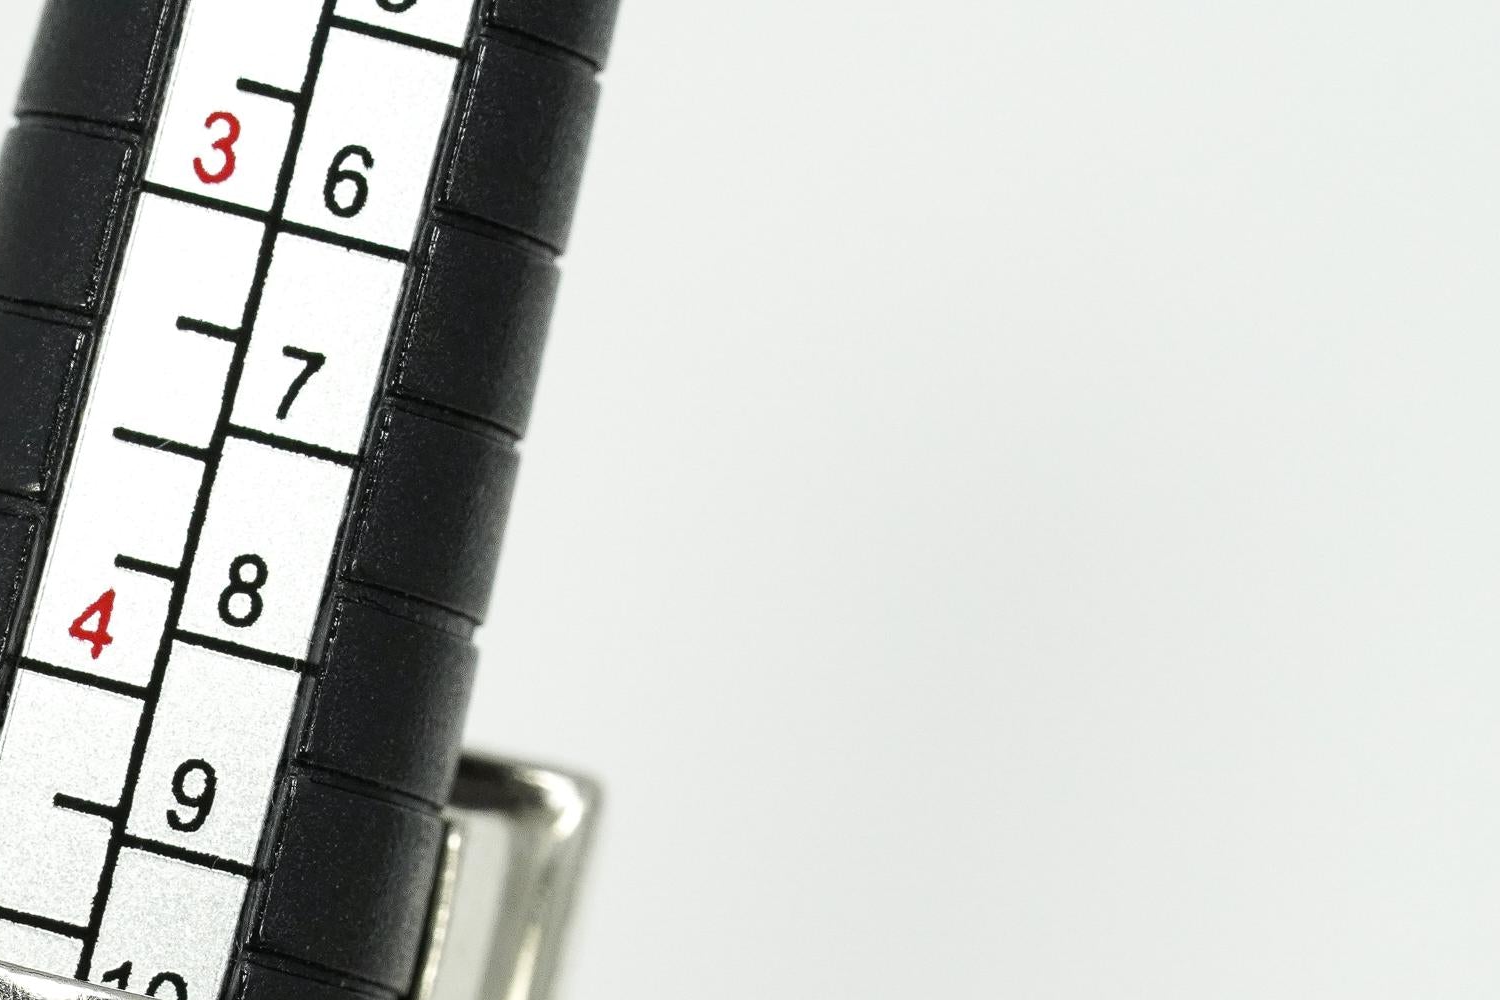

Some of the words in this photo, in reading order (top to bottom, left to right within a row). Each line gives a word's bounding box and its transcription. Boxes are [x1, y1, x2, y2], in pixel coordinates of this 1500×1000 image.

[193, 111, 241, 184] 3
[323, 144, 375, 218] 6
[282, 345, 327, 420] 7
[68, 588, 116, 660] 4
[218, 553, 269, 628] 8
[166, 758, 217, 833] 9
